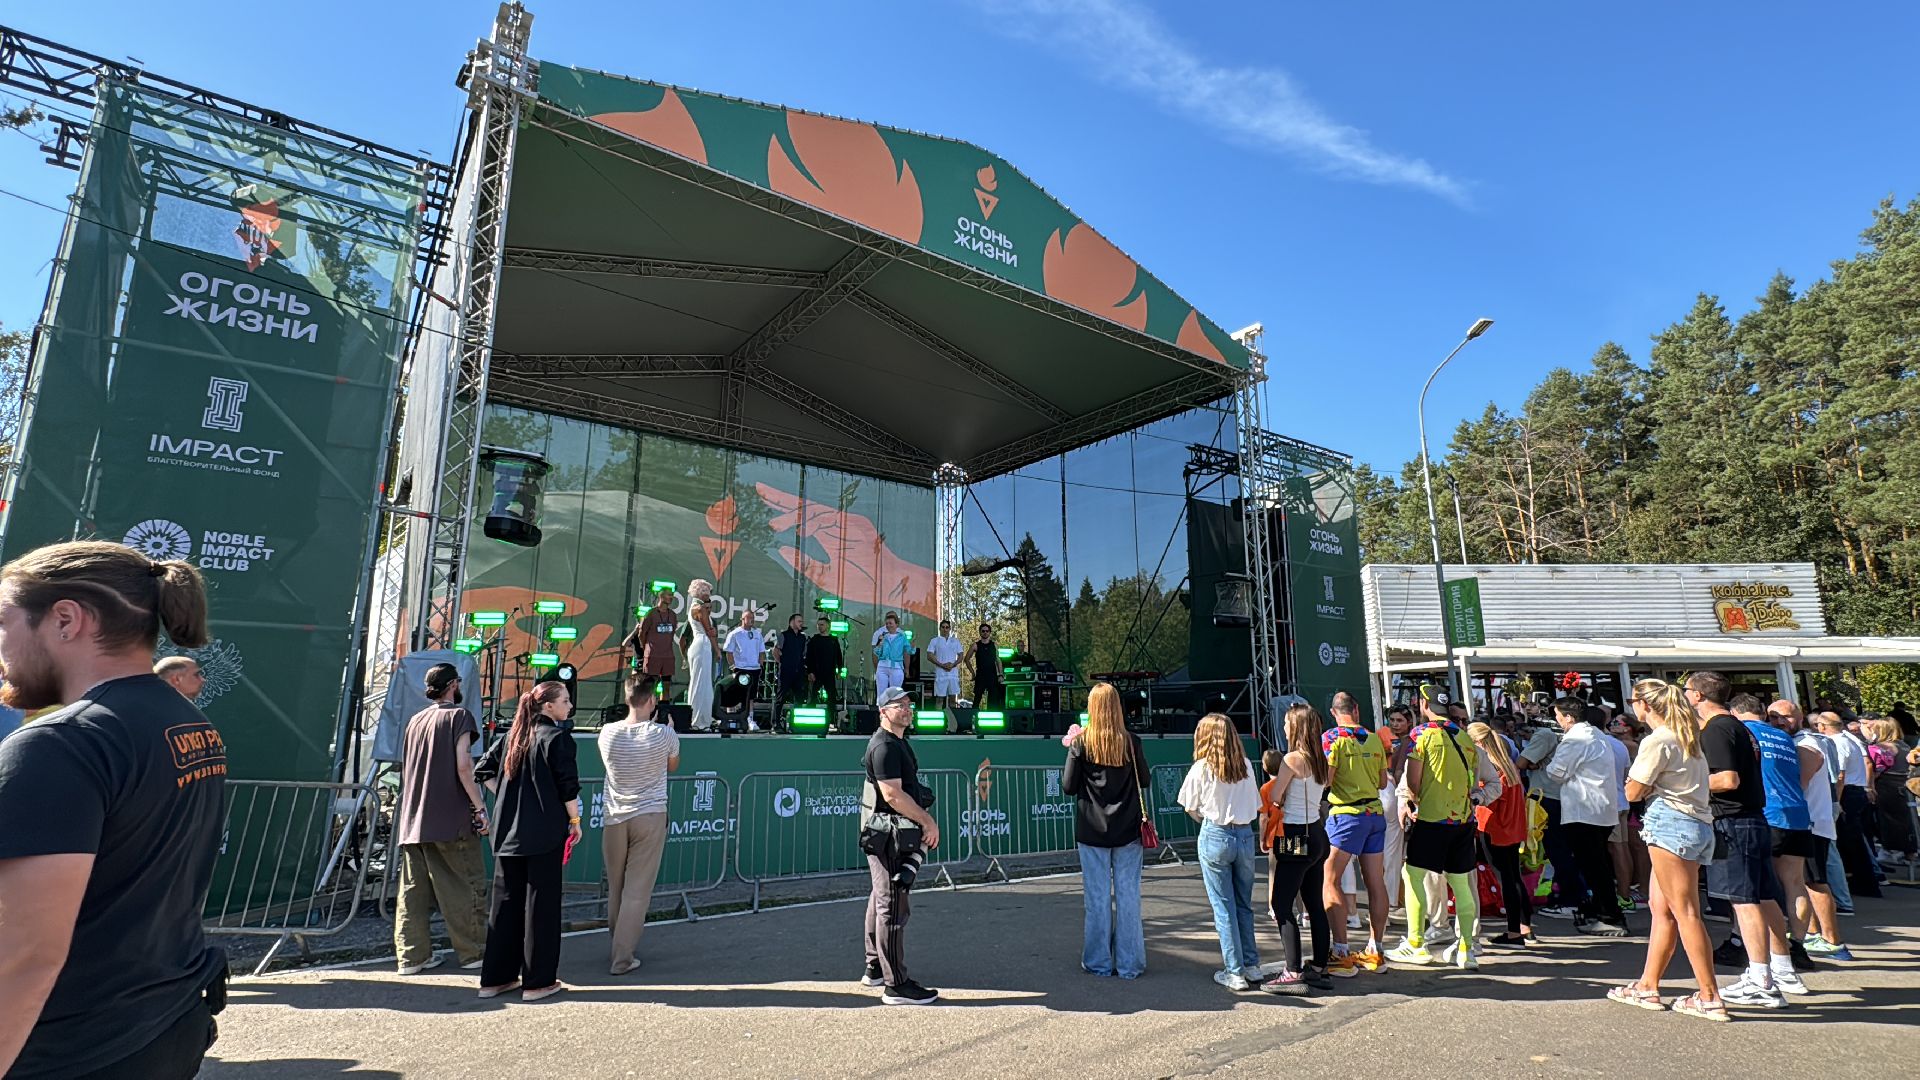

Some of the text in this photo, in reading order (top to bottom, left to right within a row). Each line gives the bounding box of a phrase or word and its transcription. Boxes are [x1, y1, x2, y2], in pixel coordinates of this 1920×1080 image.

[957, 217, 1013, 250] ОГОНЬ
[954, 230, 1018, 267] ЖИЗНИ
[180, 271, 311, 316] ОГОНЬ
[163, 293, 318, 343] ЖИЗНИ
[149, 434, 283, 466] IMPACT
[147, 456, 280, 478] БЛАГОТВОРИТЕЛЬНЫЙ ФОНД
[203, 530, 266, 547] NOBLE
[1310, 528, 1339, 543] ОГОНЬ
[201, 544, 274, 560] IMPACT
[1309, 539, 1343, 555] ЖИЗНИ
[200, 557, 249, 571] CLUB
[672, 590, 770, 622] ООНЬ
[1316, 603, 1345, 615] IMPACT
[1451, 585, 1466, 644] ТЕРРИТОРИЯ
[1465, 606, 1478, 643] СПОРТА
[962, 809, 1006, 822] ОГОНЬ
[1032, 802, 1074, 815] IMPACT
[670, 818, 736, 835] MPACT
[959, 823, 1010, 837] ЖИЗНИ
